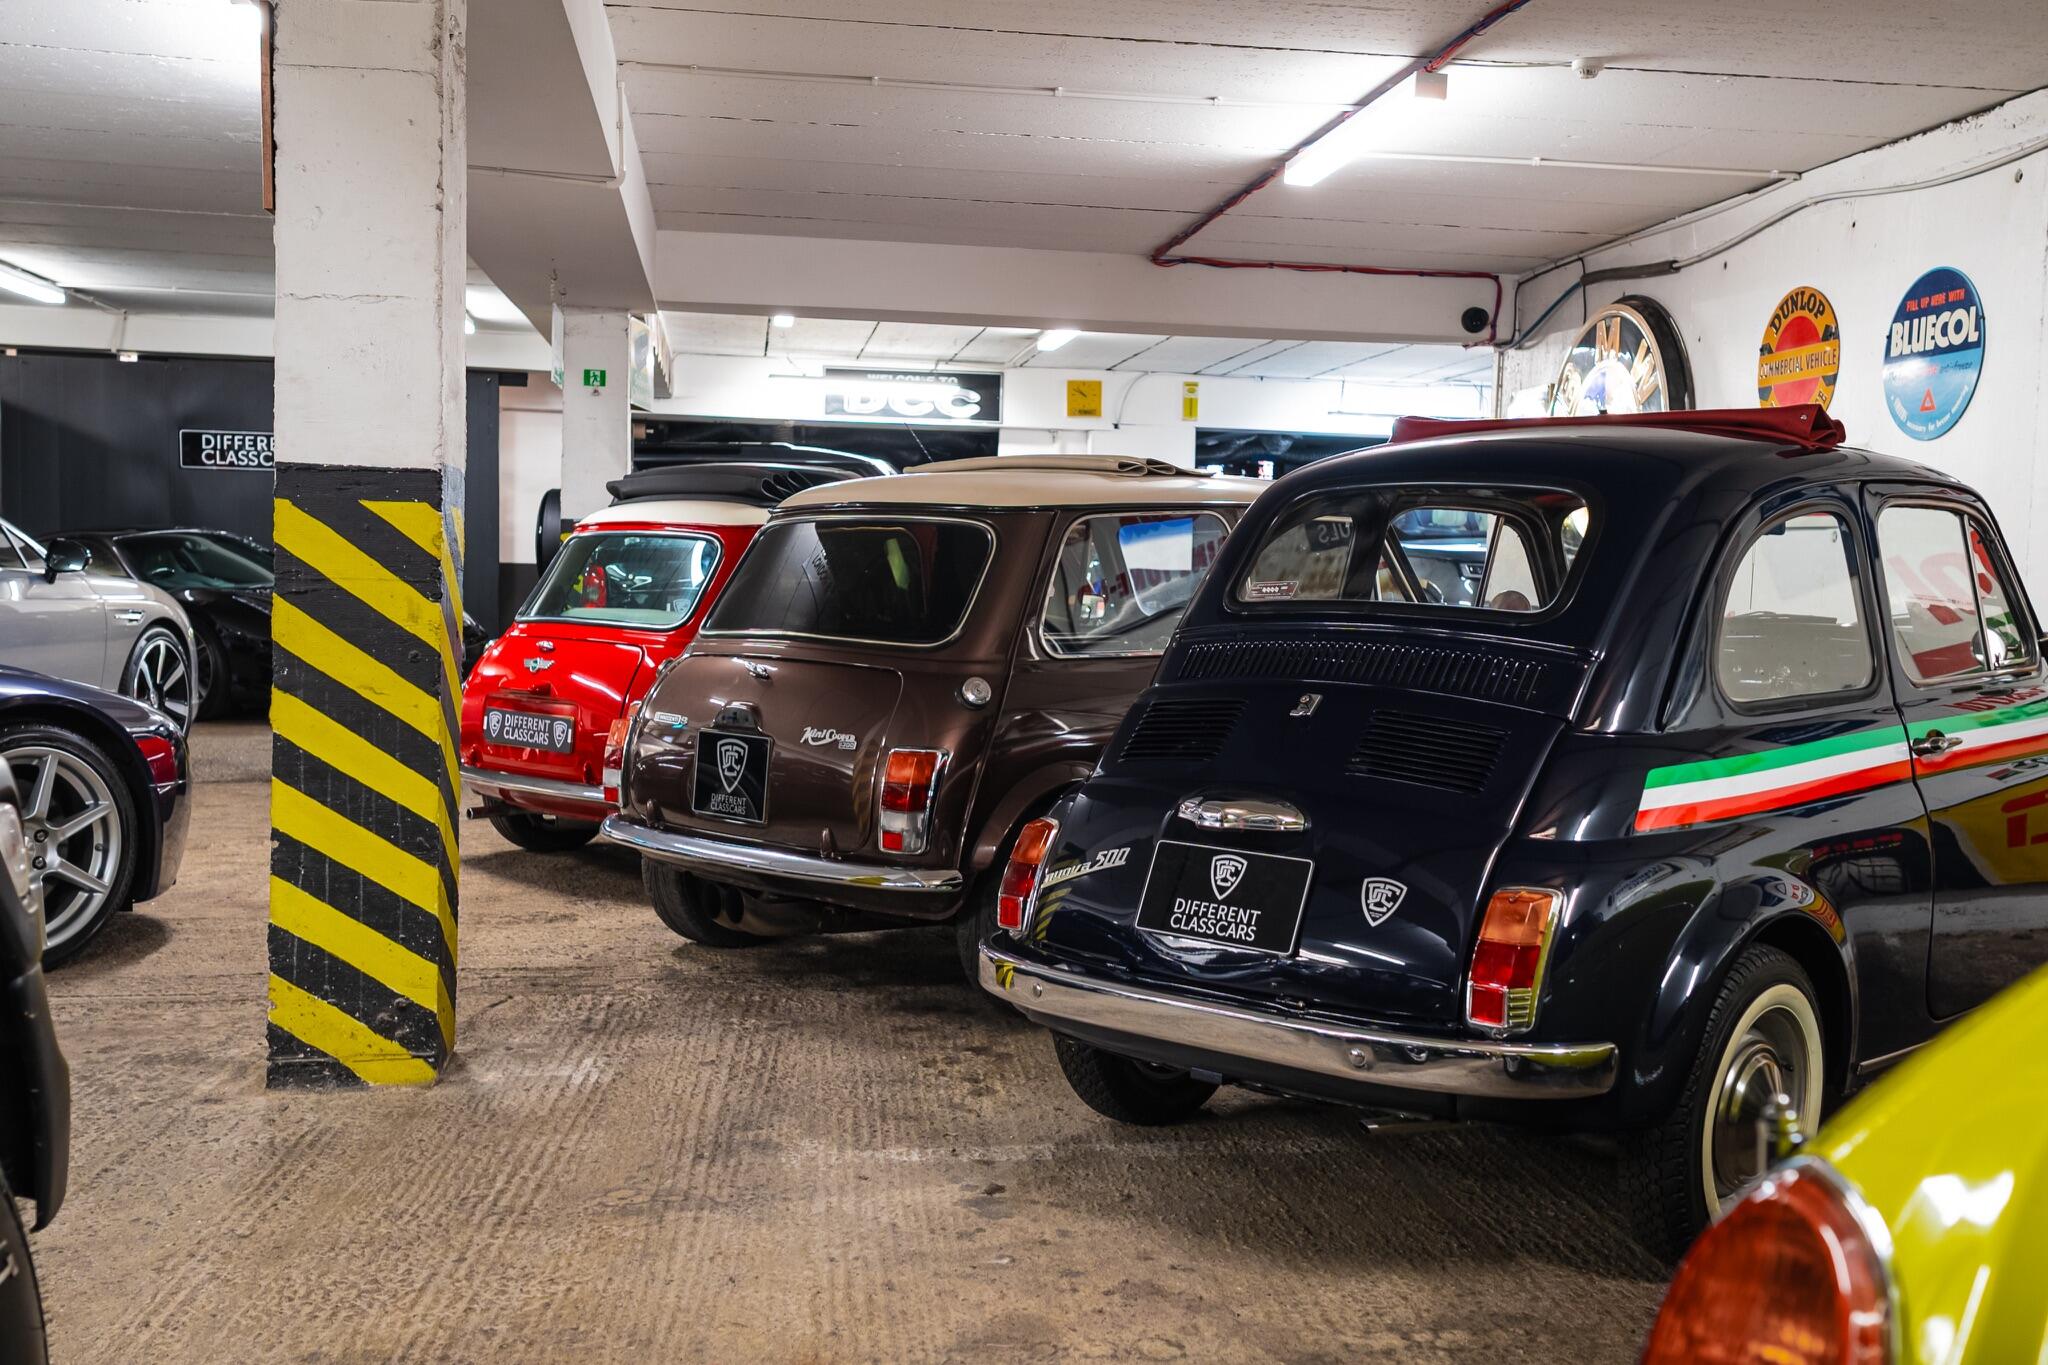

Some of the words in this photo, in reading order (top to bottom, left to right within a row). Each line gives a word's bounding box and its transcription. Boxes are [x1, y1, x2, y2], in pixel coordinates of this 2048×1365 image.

[1770, 290, 1826, 336] DUNLOP
[1891, 305, 1980, 358] BLUECOL
[1760, 355, 1804, 379] COMMERCIAL
[1805, 348, 1838, 371] VEHICLE
[504, 713, 551, 733] DIFFERENT
[503, 726, 549, 746] CLASSCARS
[710, 801, 746, 815] CLASSCARS
[711, 792, 747, 807] DIFFERENT
[1095, 847, 1131, 867] 500
[1173, 897, 1261, 925] DIFFERENT
[1169, 913, 1257, 942] CLASSCARS
